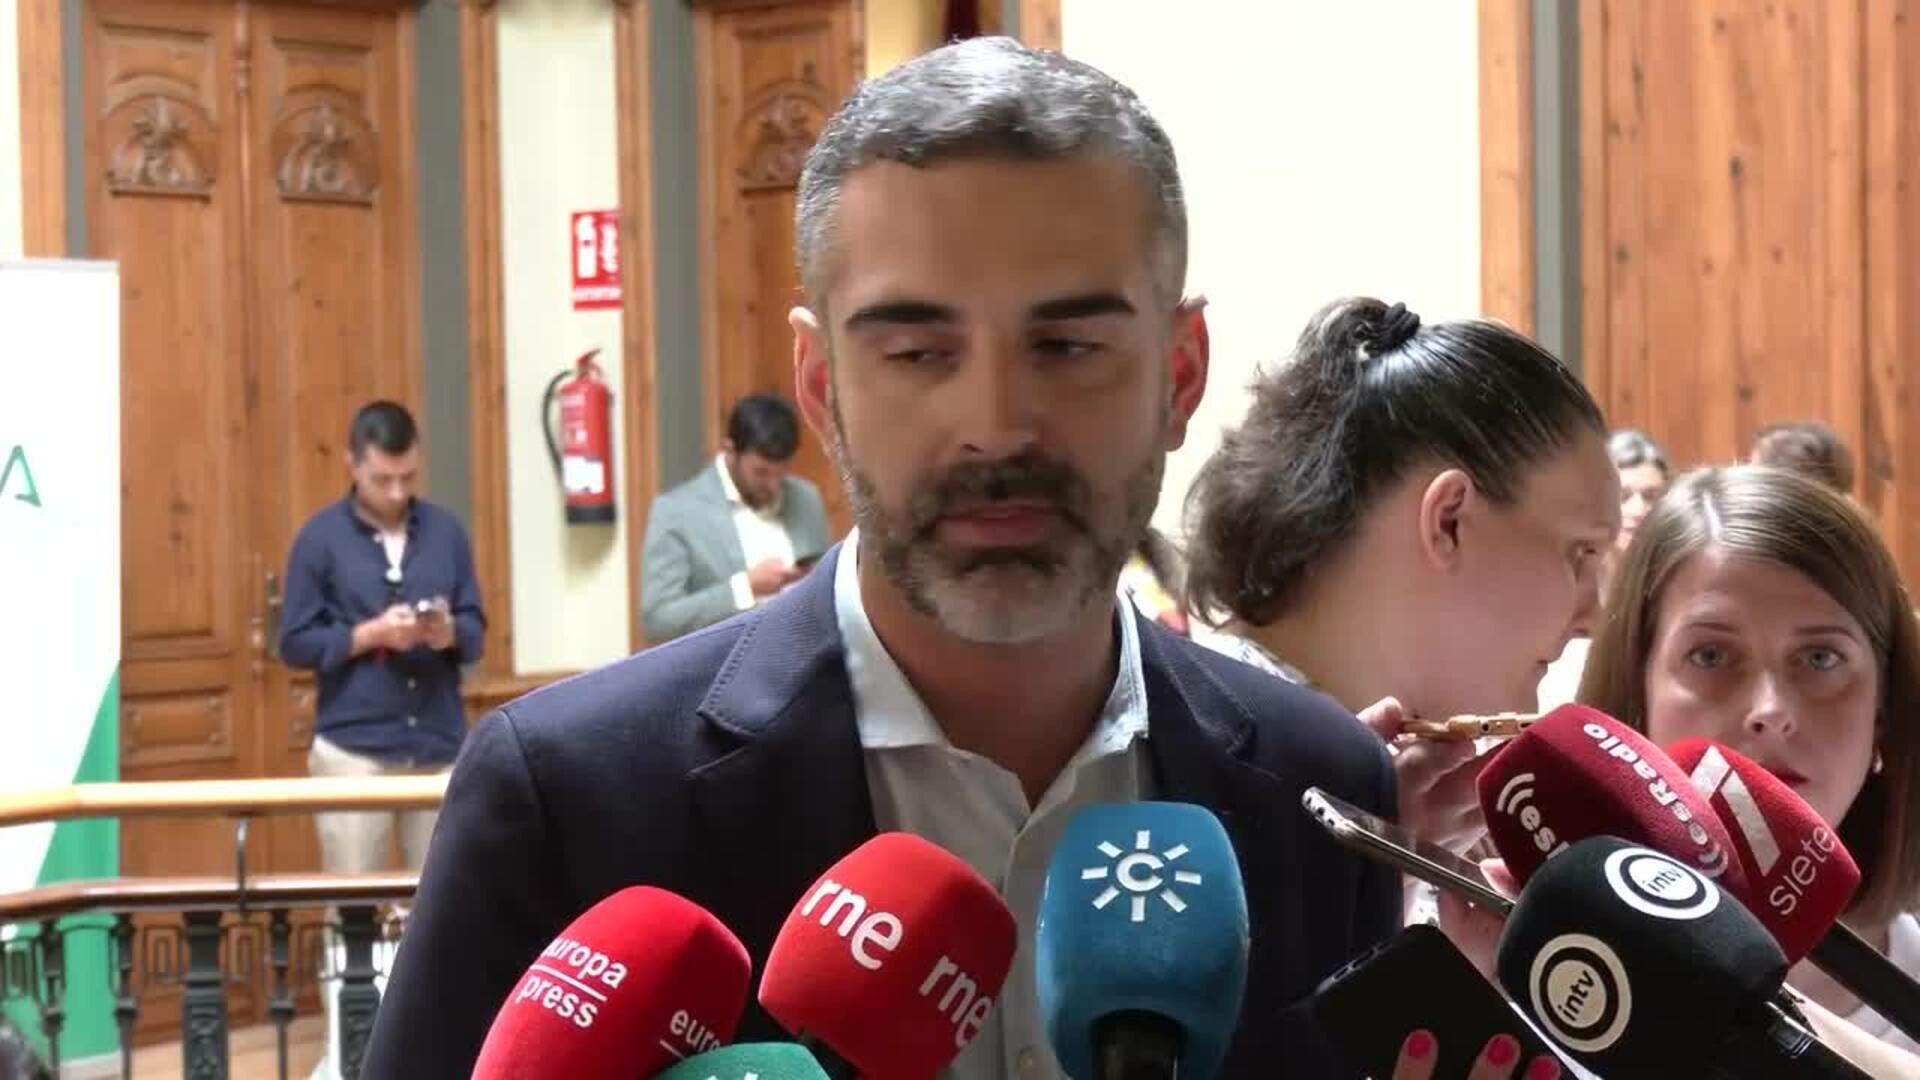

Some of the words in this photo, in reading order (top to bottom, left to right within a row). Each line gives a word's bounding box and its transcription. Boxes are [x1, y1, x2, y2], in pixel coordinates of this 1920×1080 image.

[1583, 722, 1708, 845] esRadio
[1519, 805, 1571, 860] es
[1642, 867, 1683, 893] intv
[801, 879, 904, 971] rne
[541, 937, 628, 988] uropa
[514, 975, 598, 1029] press
[919, 955, 993, 1050] rne
[1558, 970, 1596, 1022] intv
